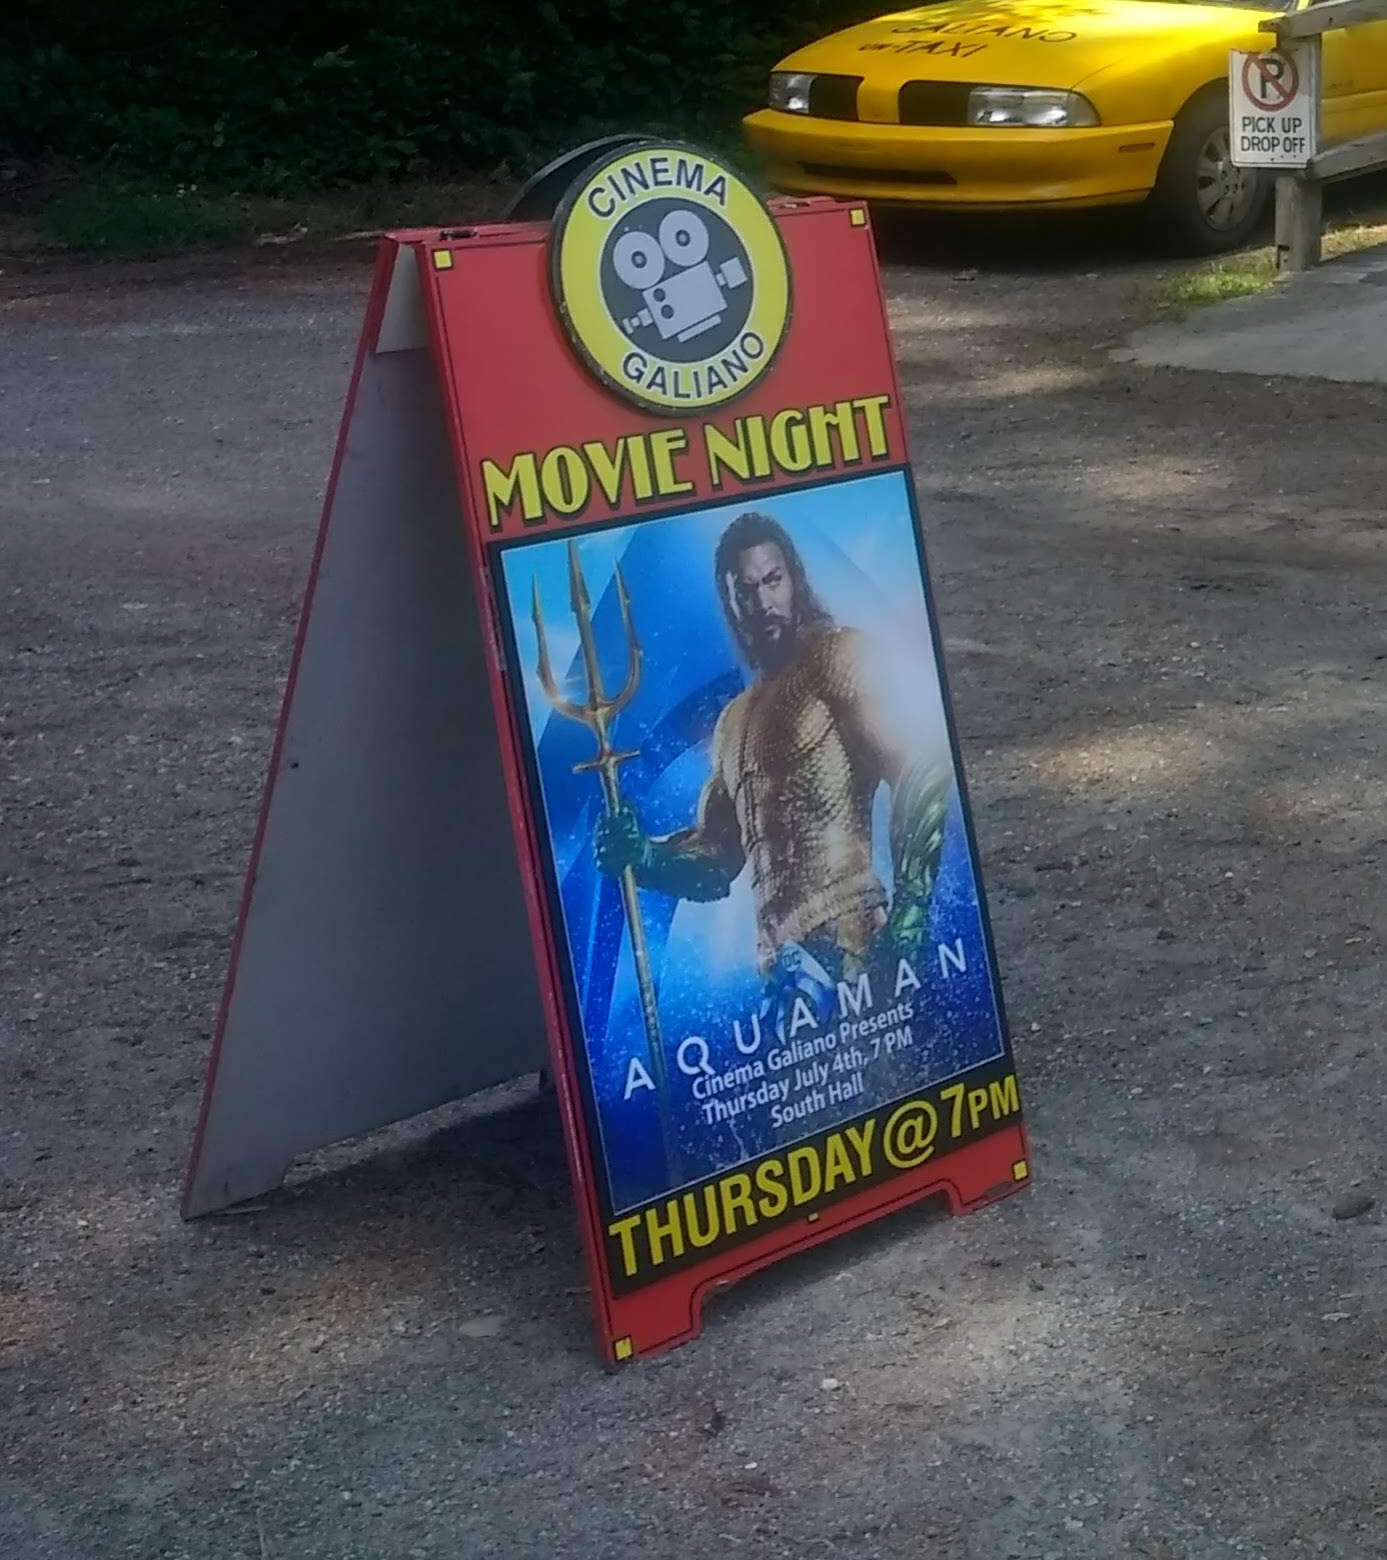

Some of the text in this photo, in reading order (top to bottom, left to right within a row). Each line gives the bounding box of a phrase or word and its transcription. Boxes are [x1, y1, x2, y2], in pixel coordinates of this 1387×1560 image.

[891, 23, 1078, 42] GALIANO
[1240, 136, 1305, 153] DROP OFF
[1241, 116, 1302, 133] PICK UP
[586, 155, 729, 218] CINEMA
[621, 331, 765, 399] GALIANO
[480, 394, 890, 528] MOVIE NIGHT
[623, 938, 967, 1101] AQUAMAN
[692, 1001, 914, 1100] Cinema Galiano Presents
[702, 1024, 913, 1125] Thursday July 4th, 7 PM
[771, 1070, 864, 1129] South Hall
[608, 1118, 877, 1278] THURSDAY
